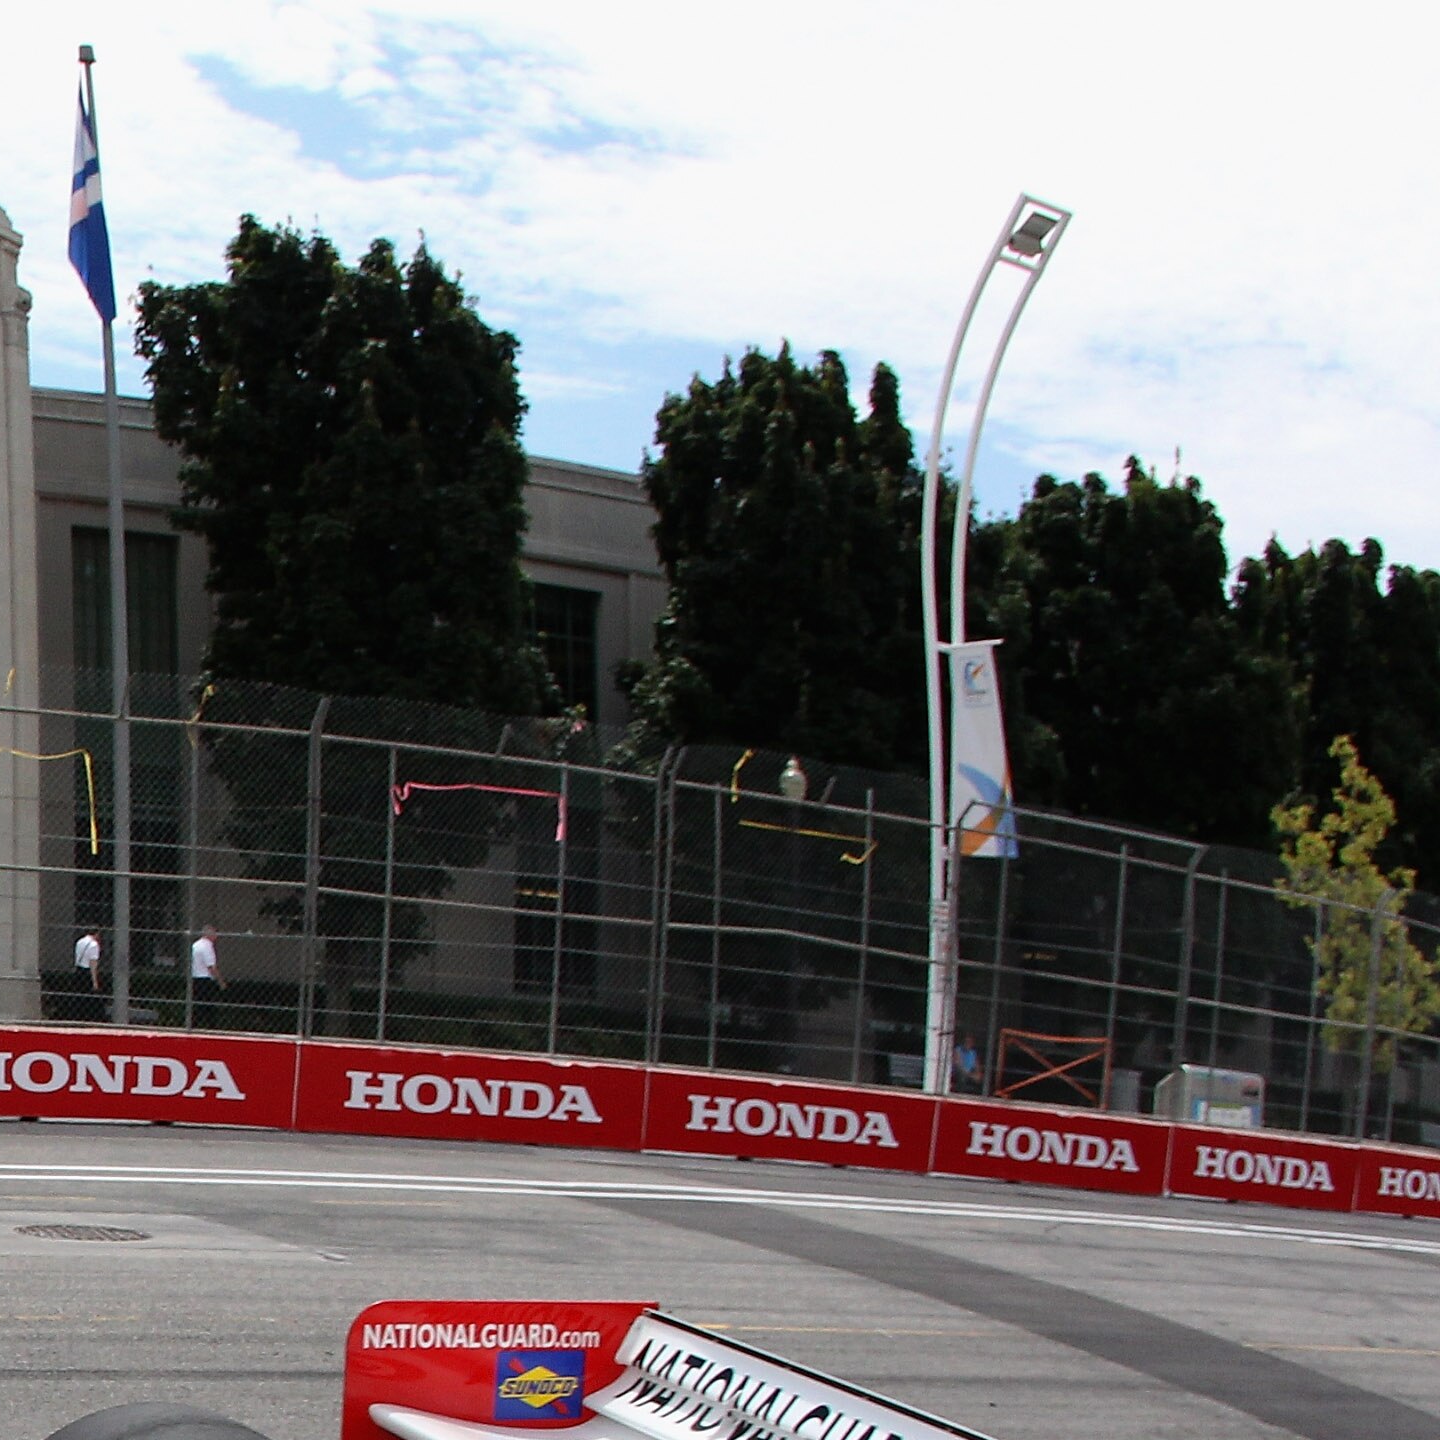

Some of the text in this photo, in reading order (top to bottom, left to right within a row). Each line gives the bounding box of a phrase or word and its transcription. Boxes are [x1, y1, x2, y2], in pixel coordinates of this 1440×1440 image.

[343, 1070, 603, 1124] HONDA
[686, 1094, 900, 1149] HONDA
[966, 1120, 1140, 1174] HONDA
[1193, 1145, 1336, 1193] HONDA
[1378, 1166, 1440, 1201] HON
[362, 1323, 601, 1350] NATIONALGUARD.com
[501, 1378, 576, 1397] SUNOCO
